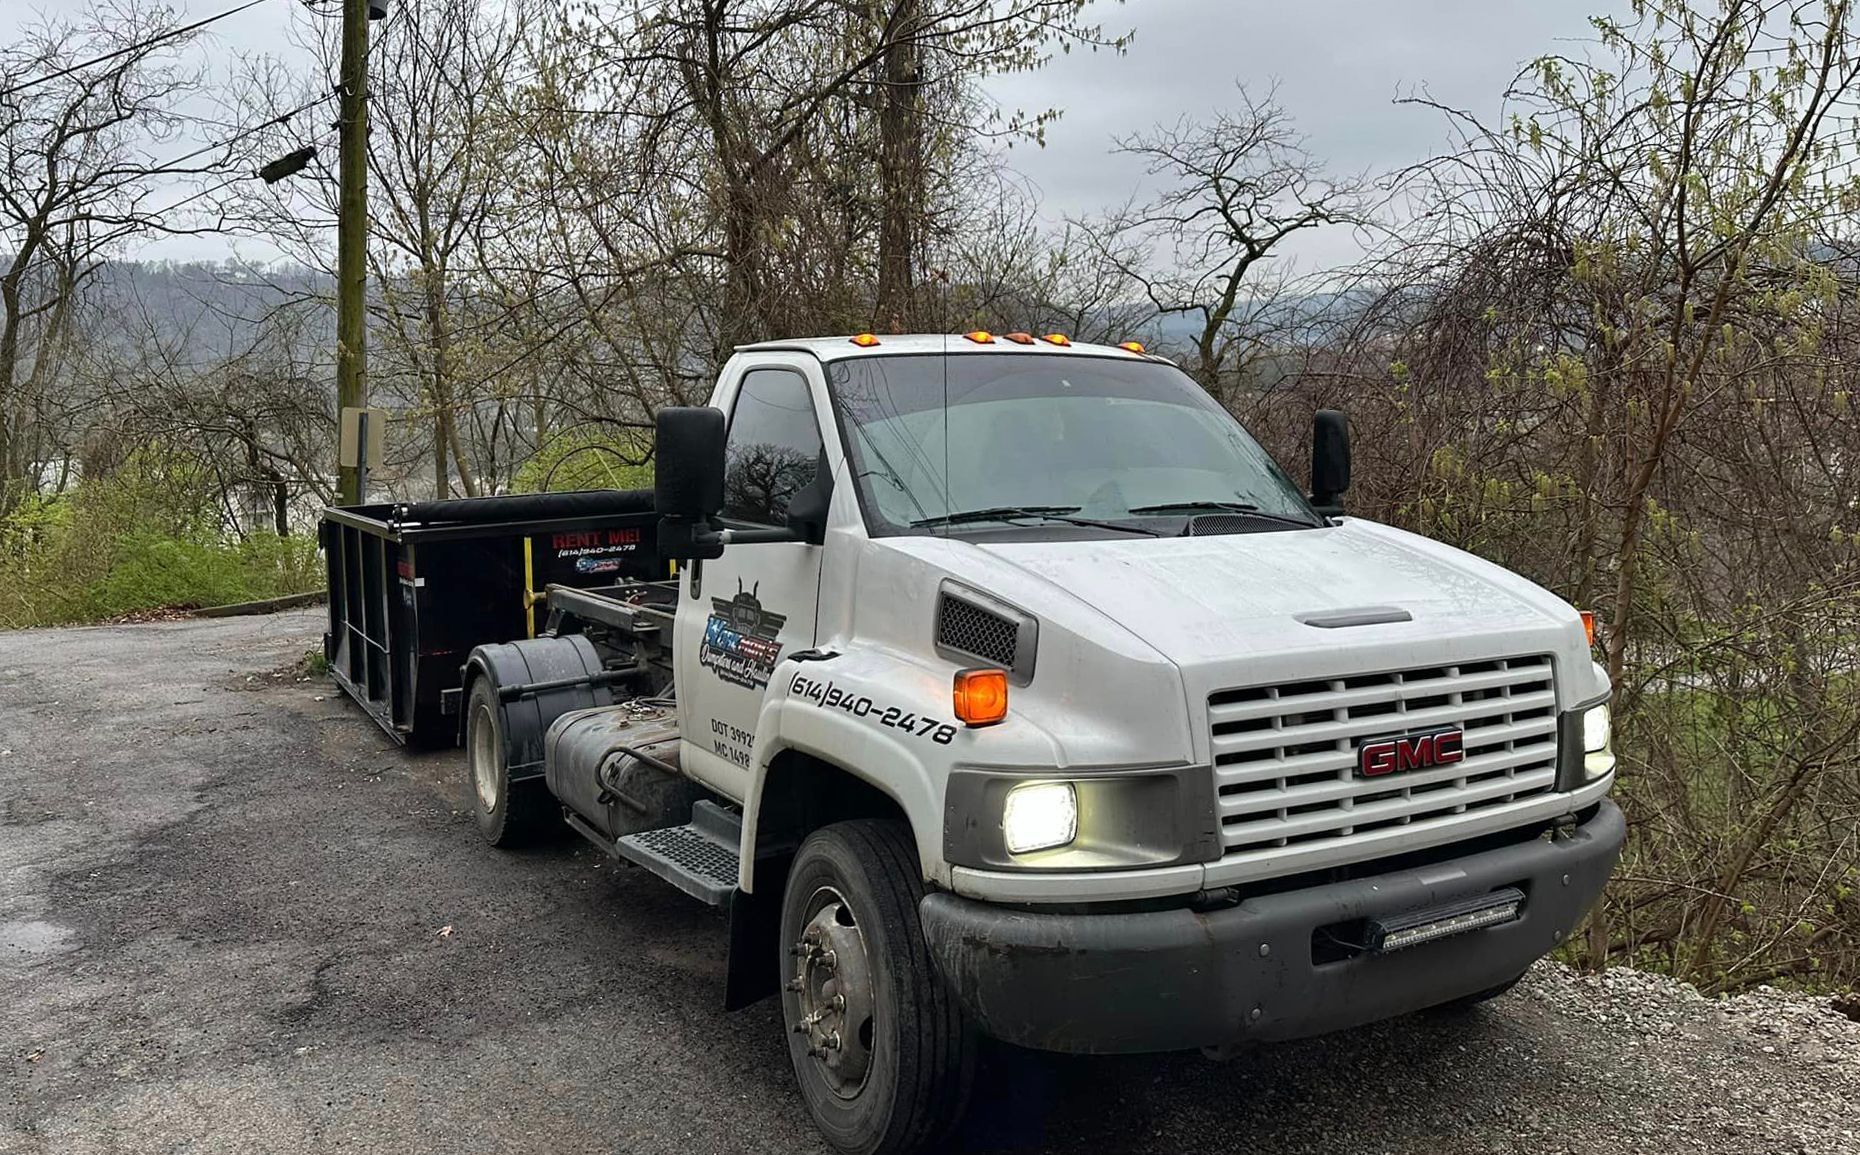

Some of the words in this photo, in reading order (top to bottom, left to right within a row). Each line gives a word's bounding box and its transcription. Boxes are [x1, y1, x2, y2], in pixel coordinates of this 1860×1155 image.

[552, 531, 602, 549] RENT
[608, 527, 640, 545] ME!
[557, 544, 636, 558] (614)940-2478
[731, 658, 746, 674] and
[787, 671, 958, 746] (614)940-2478
[711, 718, 728, 738] DOT
[730, 726, 755, 748] 3992
[713, 739, 728, 757] MC
[729, 746, 753, 768] 1498
[1361, 731, 1464, 776] GMC
